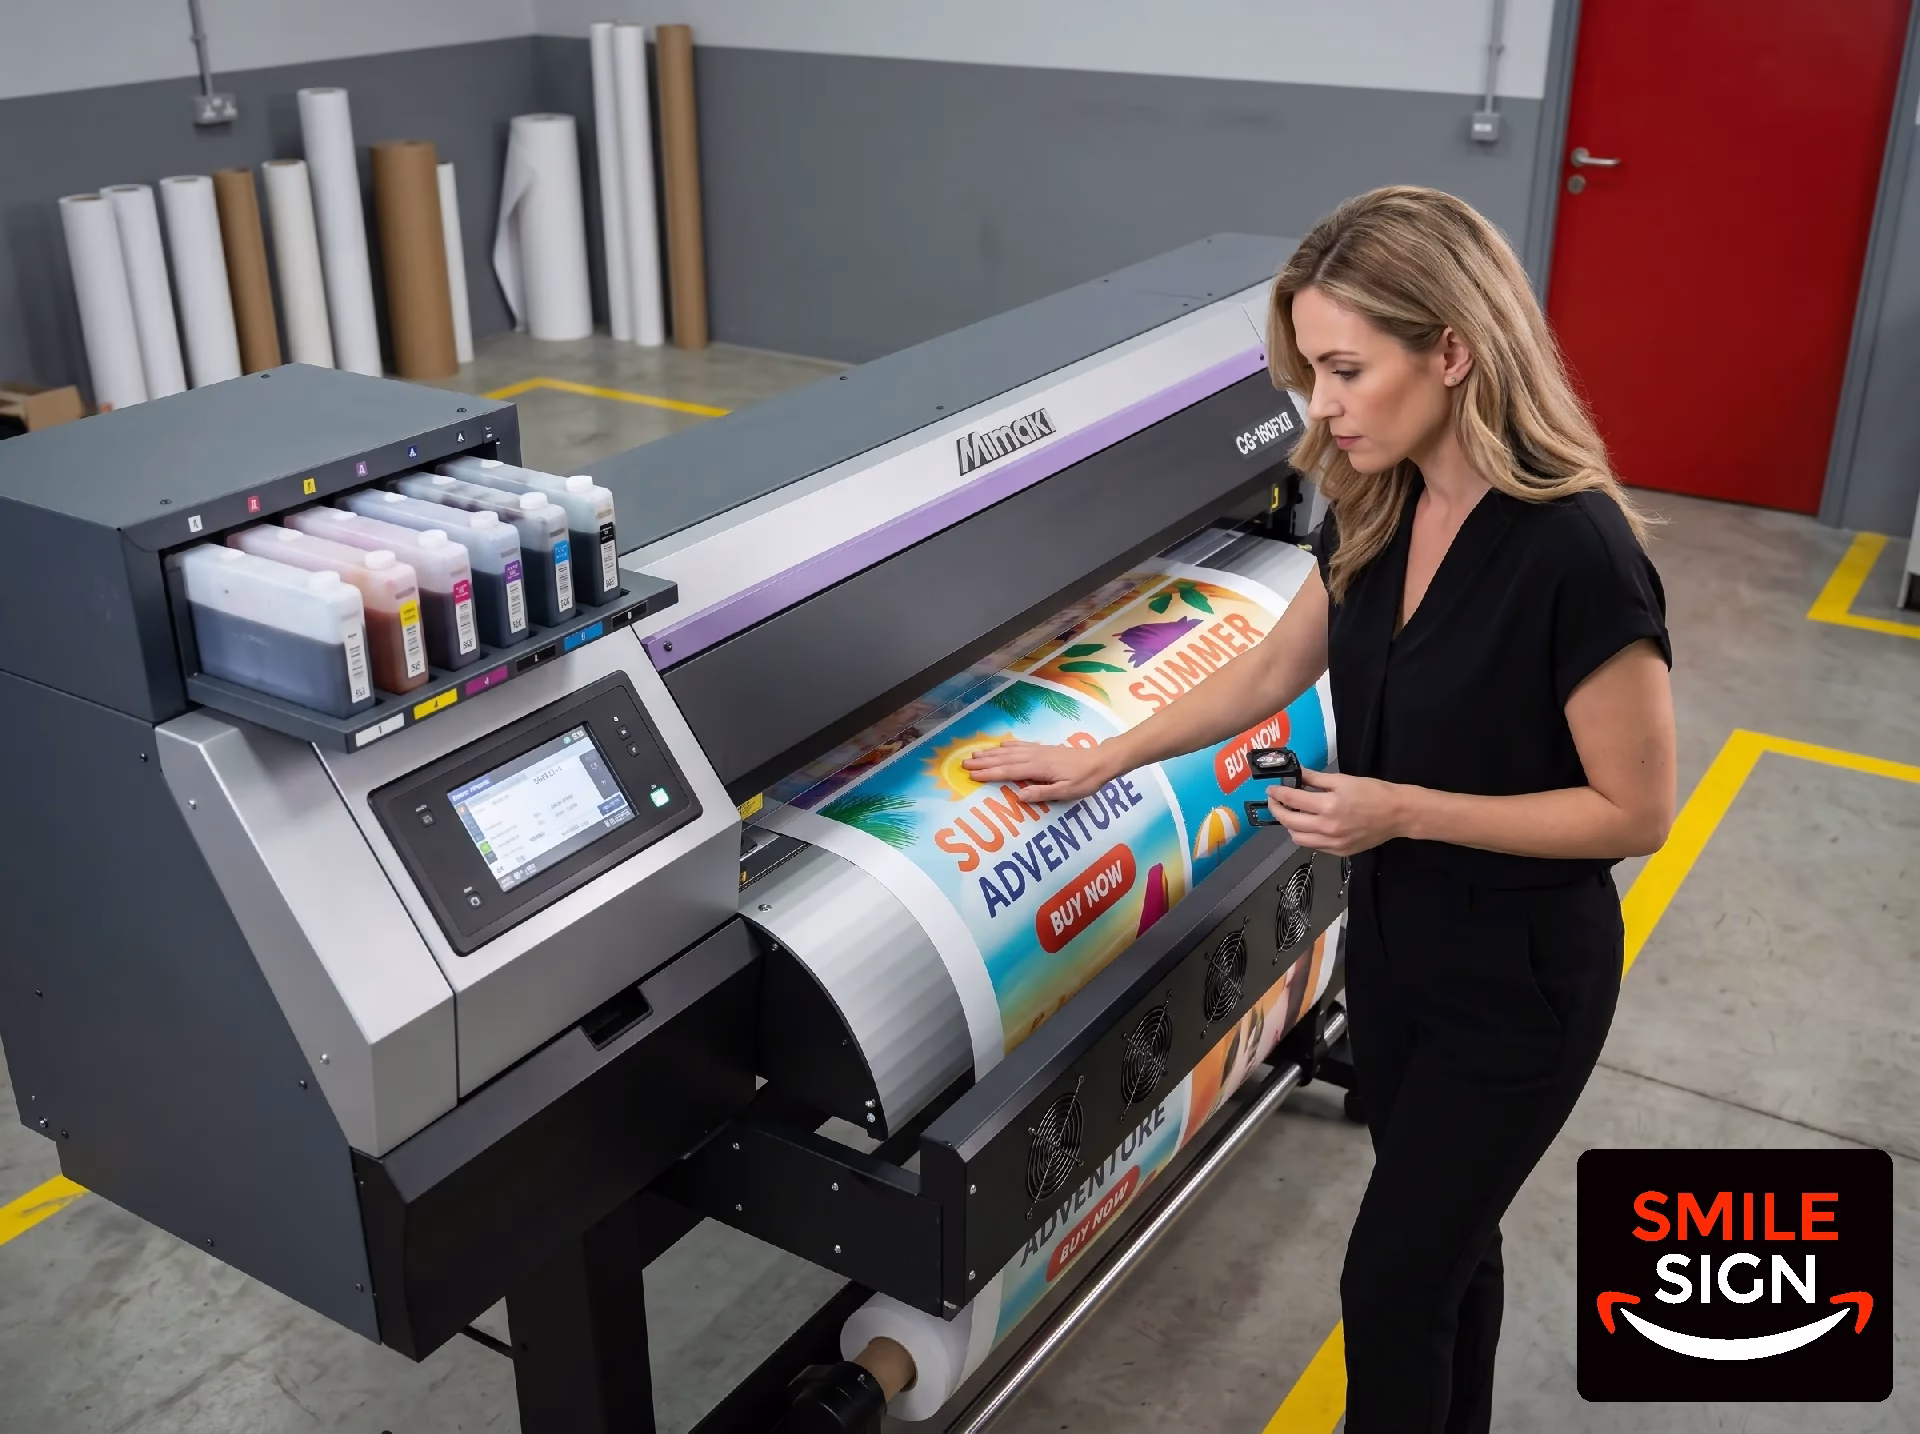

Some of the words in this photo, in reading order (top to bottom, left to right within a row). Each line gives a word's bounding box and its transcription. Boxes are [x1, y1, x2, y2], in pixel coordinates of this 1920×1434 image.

[956, 407, 1056, 476] Mimaki
[1128, 613, 1265, 713] SUMMER
[1224, 742, 1249, 780] BUY
[1250, 717, 1281, 750] NOW
[978, 775, 1144, 918] ADVENTURE
[1049, 898, 1083, 937] BUY
[1085, 860, 1123, 902] NOW
[1060, 1220, 1091, 1264] BUY
[1092, 1181, 1129, 1230] NOW
